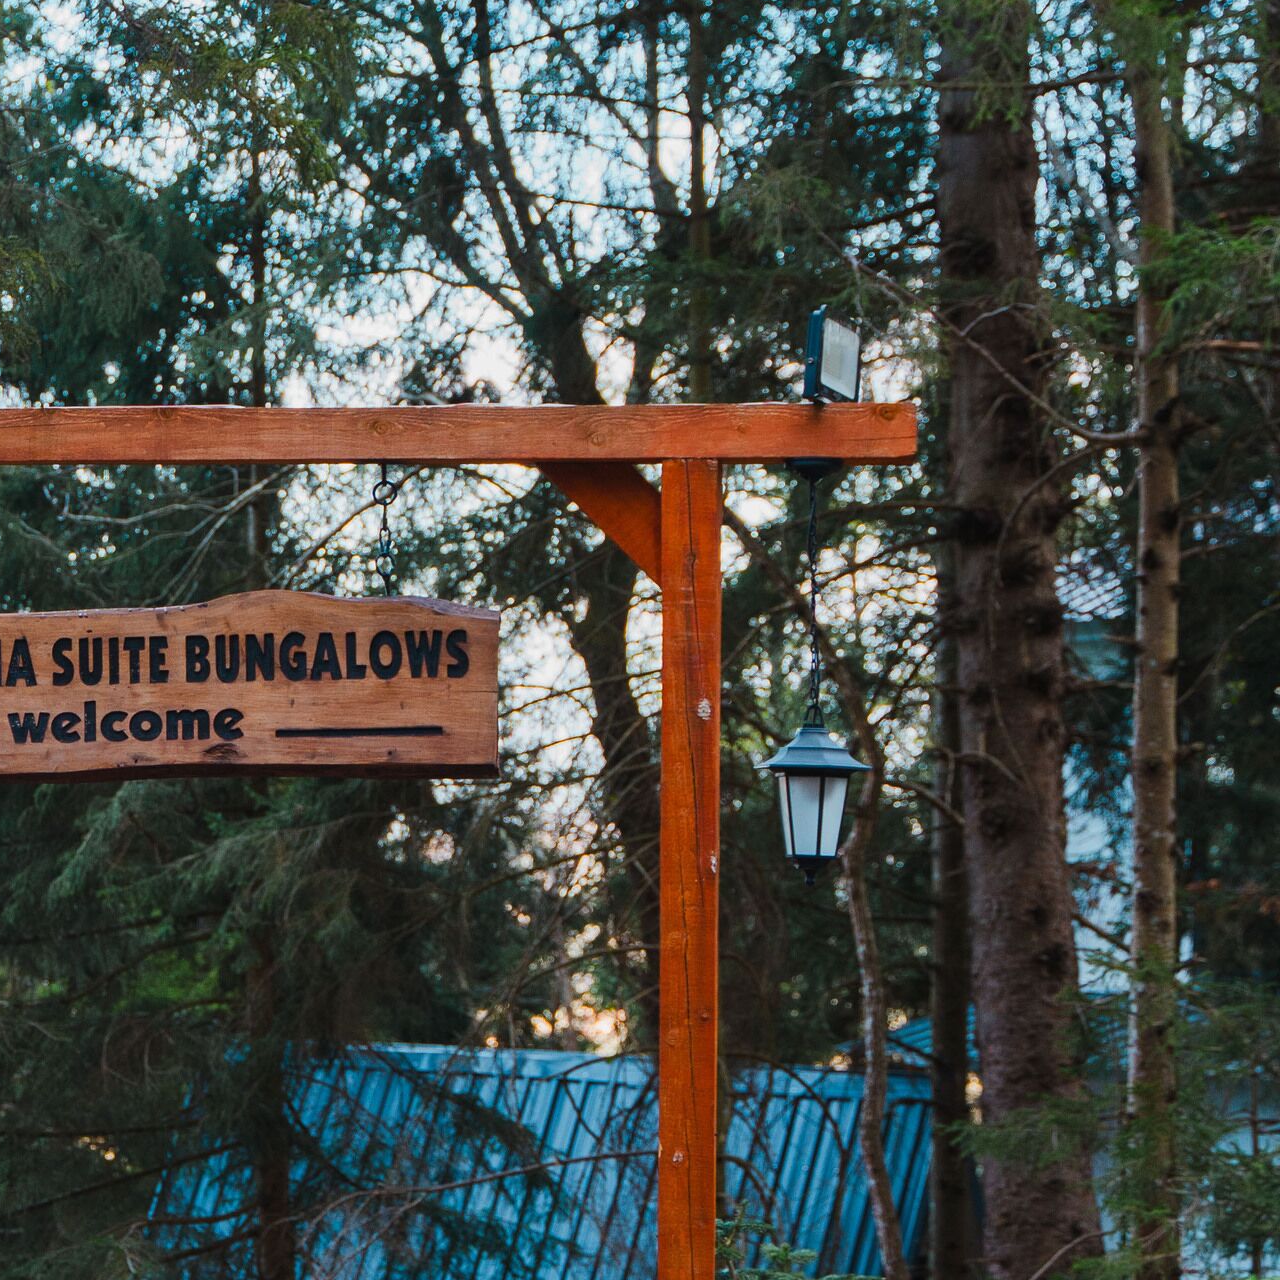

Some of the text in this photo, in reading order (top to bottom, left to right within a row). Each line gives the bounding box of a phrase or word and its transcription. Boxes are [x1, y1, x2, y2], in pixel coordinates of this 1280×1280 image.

[52, 636, 169, 686] SUITE
[186, 630, 470, 683] BUNGALOWS
[9, 701, 244, 743] welcome
